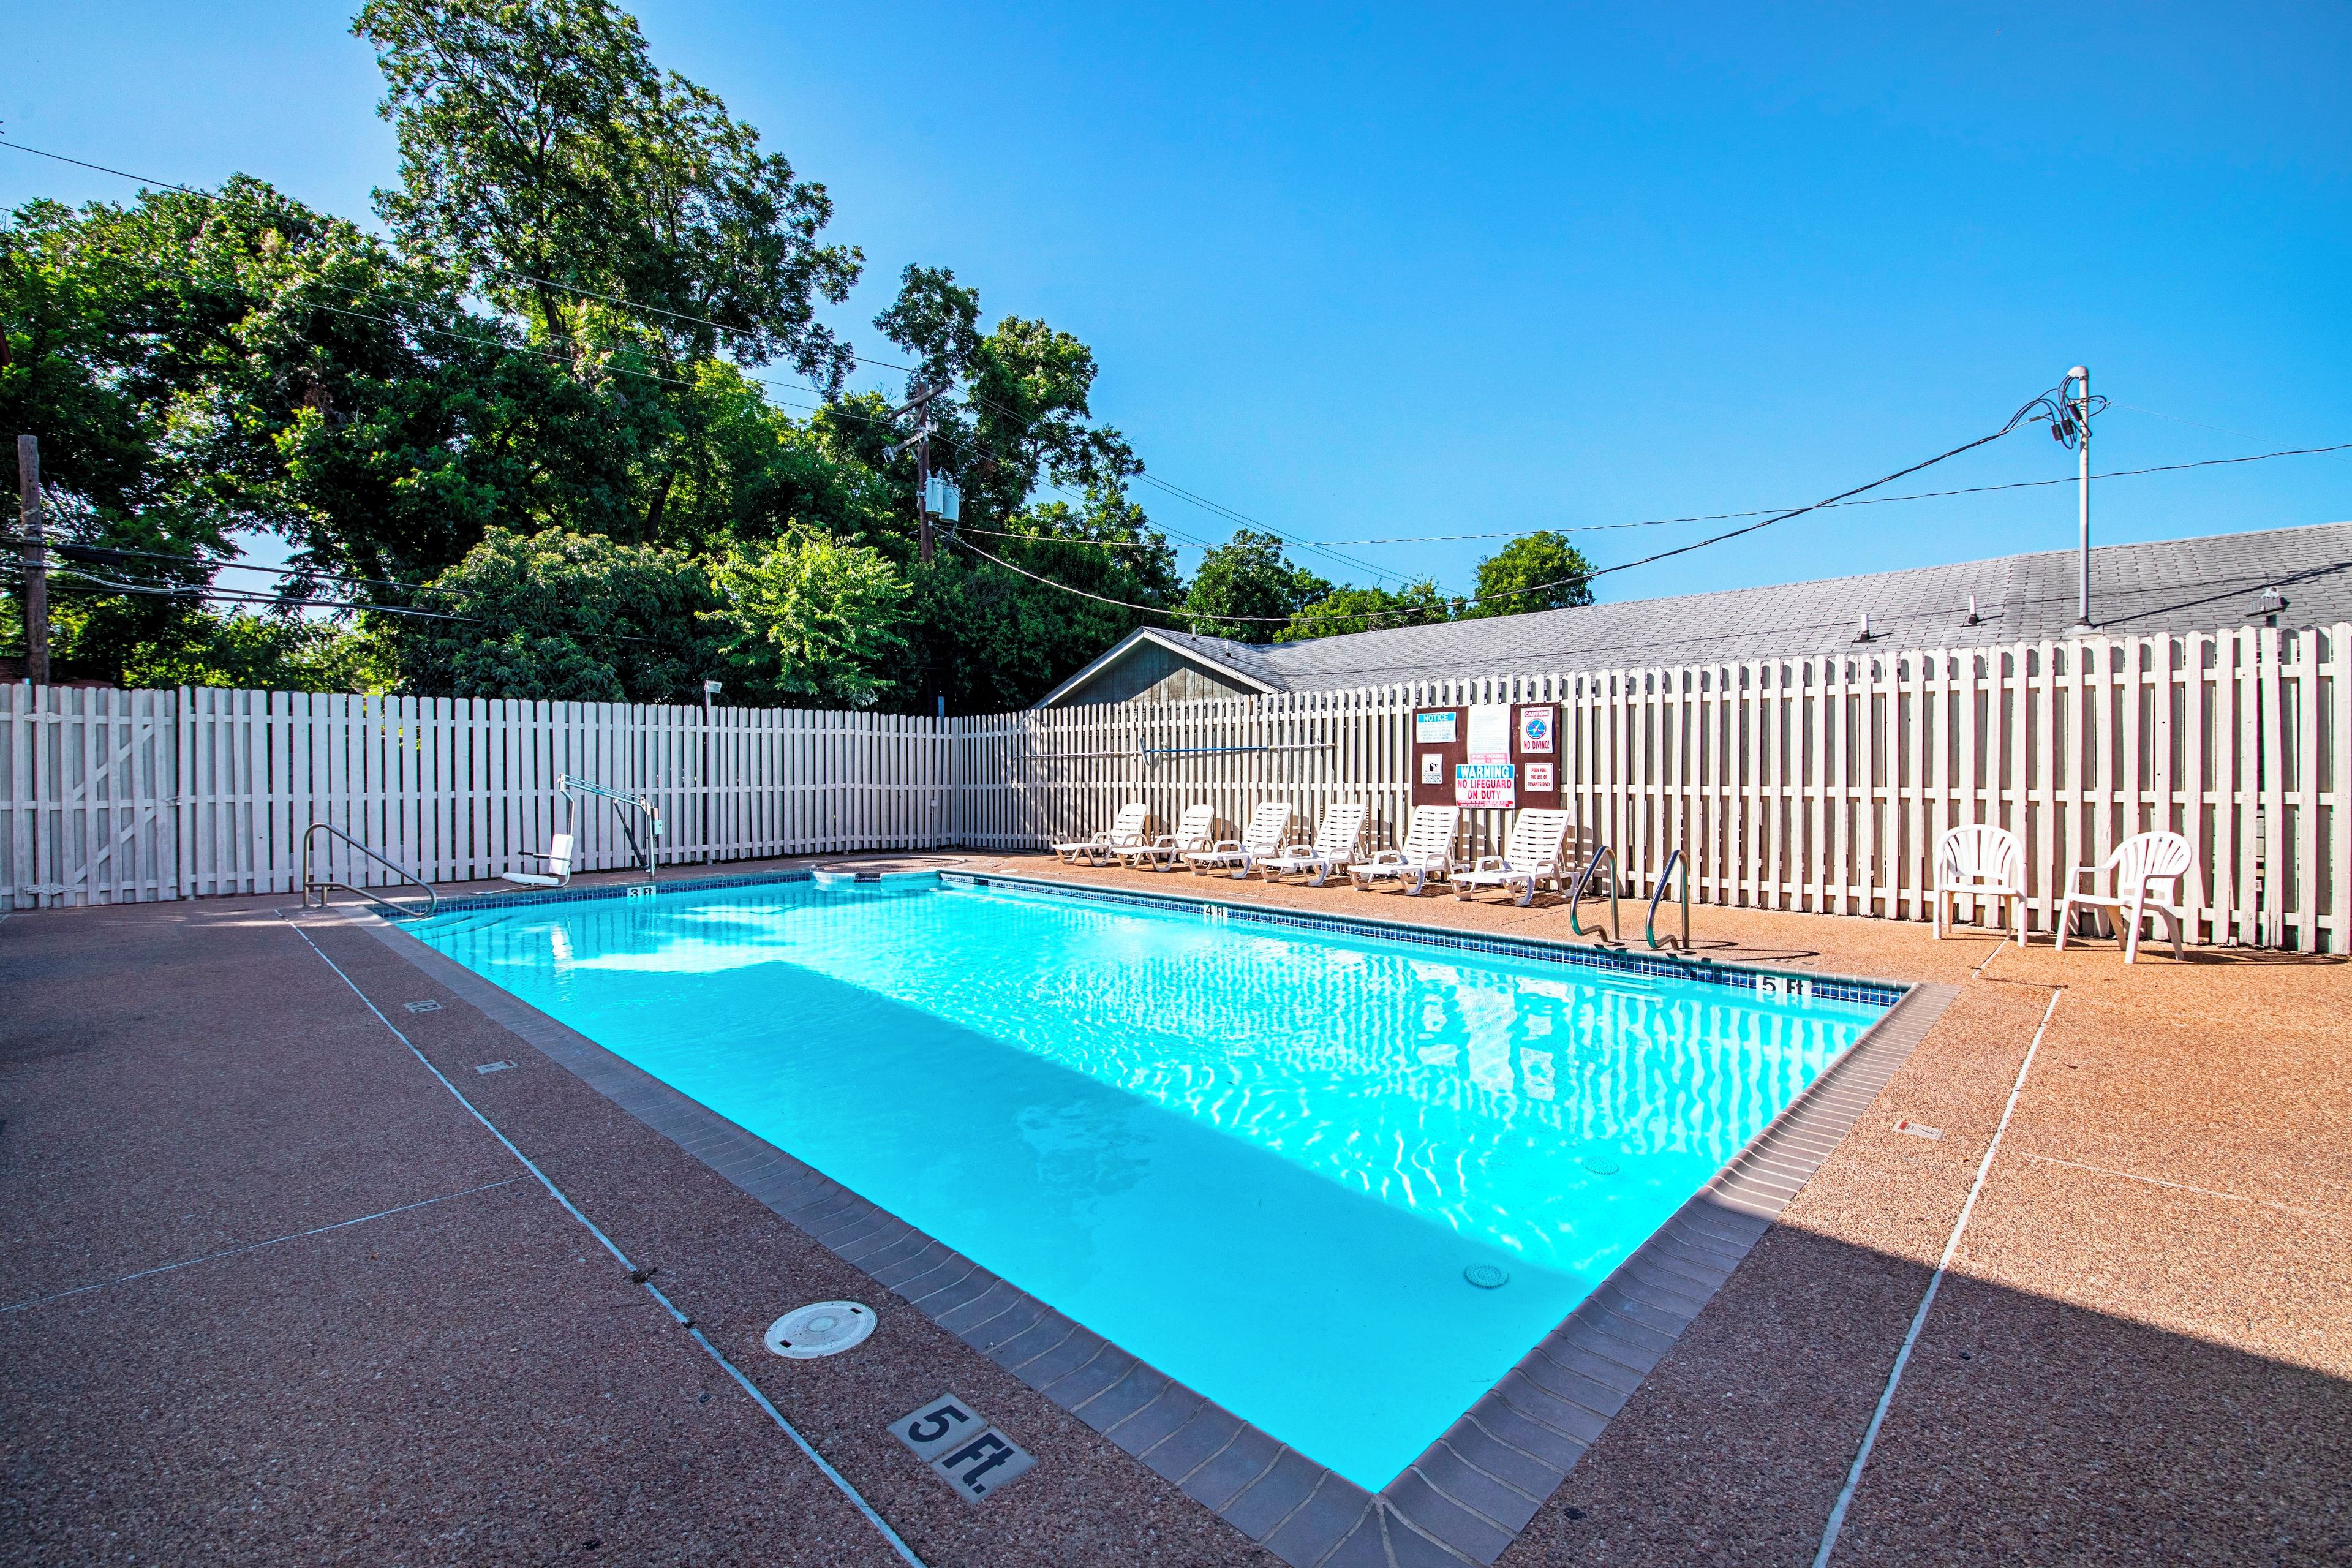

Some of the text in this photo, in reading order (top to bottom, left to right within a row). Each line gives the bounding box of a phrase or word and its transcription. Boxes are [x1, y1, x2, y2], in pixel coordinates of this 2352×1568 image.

[1524, 740, 1550, 750] NO DIVING!
[1461, 766, 1509, 778] WARNING
[1458, 779, 1512, 788] NO LIFEGUARD
[1468, 790, 1501, 799] ON DUTY
[630, 889, 638, 897] 3
[1206, 905, 1213, 916] 4
[1763, 976, 1776, 991] 5
[908, 1404, 1015, 1494] 5 Ft.
